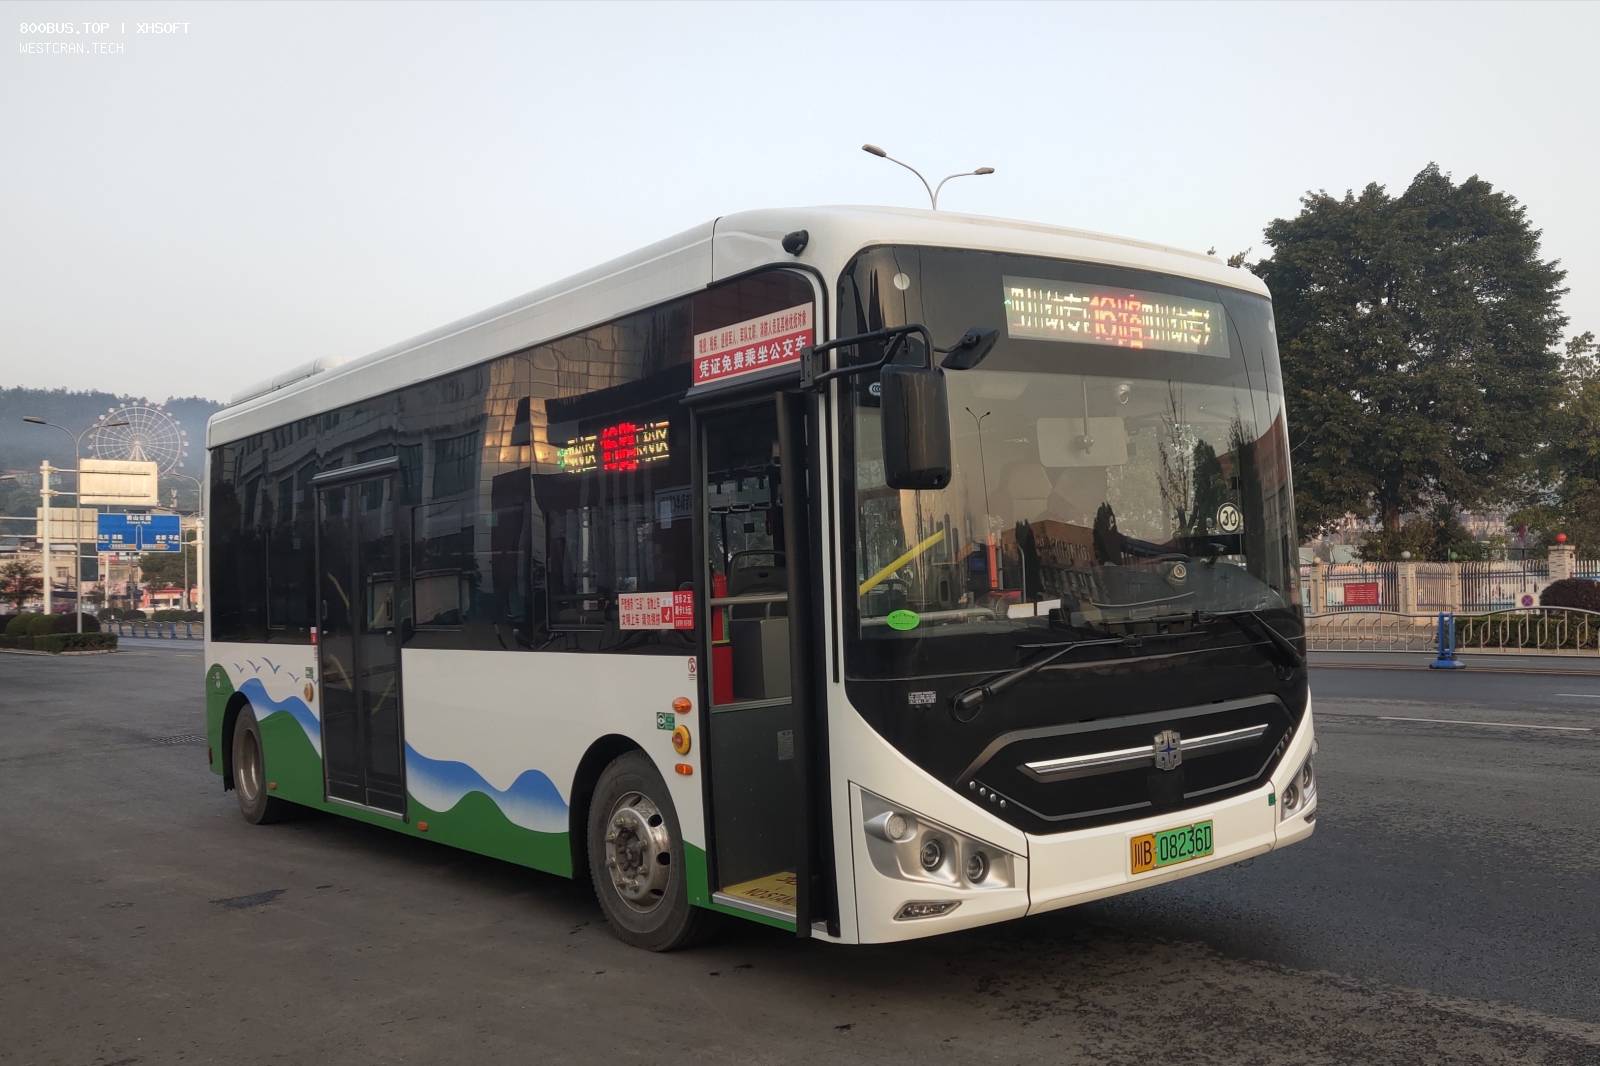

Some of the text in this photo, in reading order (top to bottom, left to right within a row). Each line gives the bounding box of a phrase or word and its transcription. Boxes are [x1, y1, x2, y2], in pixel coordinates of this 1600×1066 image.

[699, 335, 807, 379] 凭证免费乘坐公交车
[1222, 510, 1237, 526] 30
